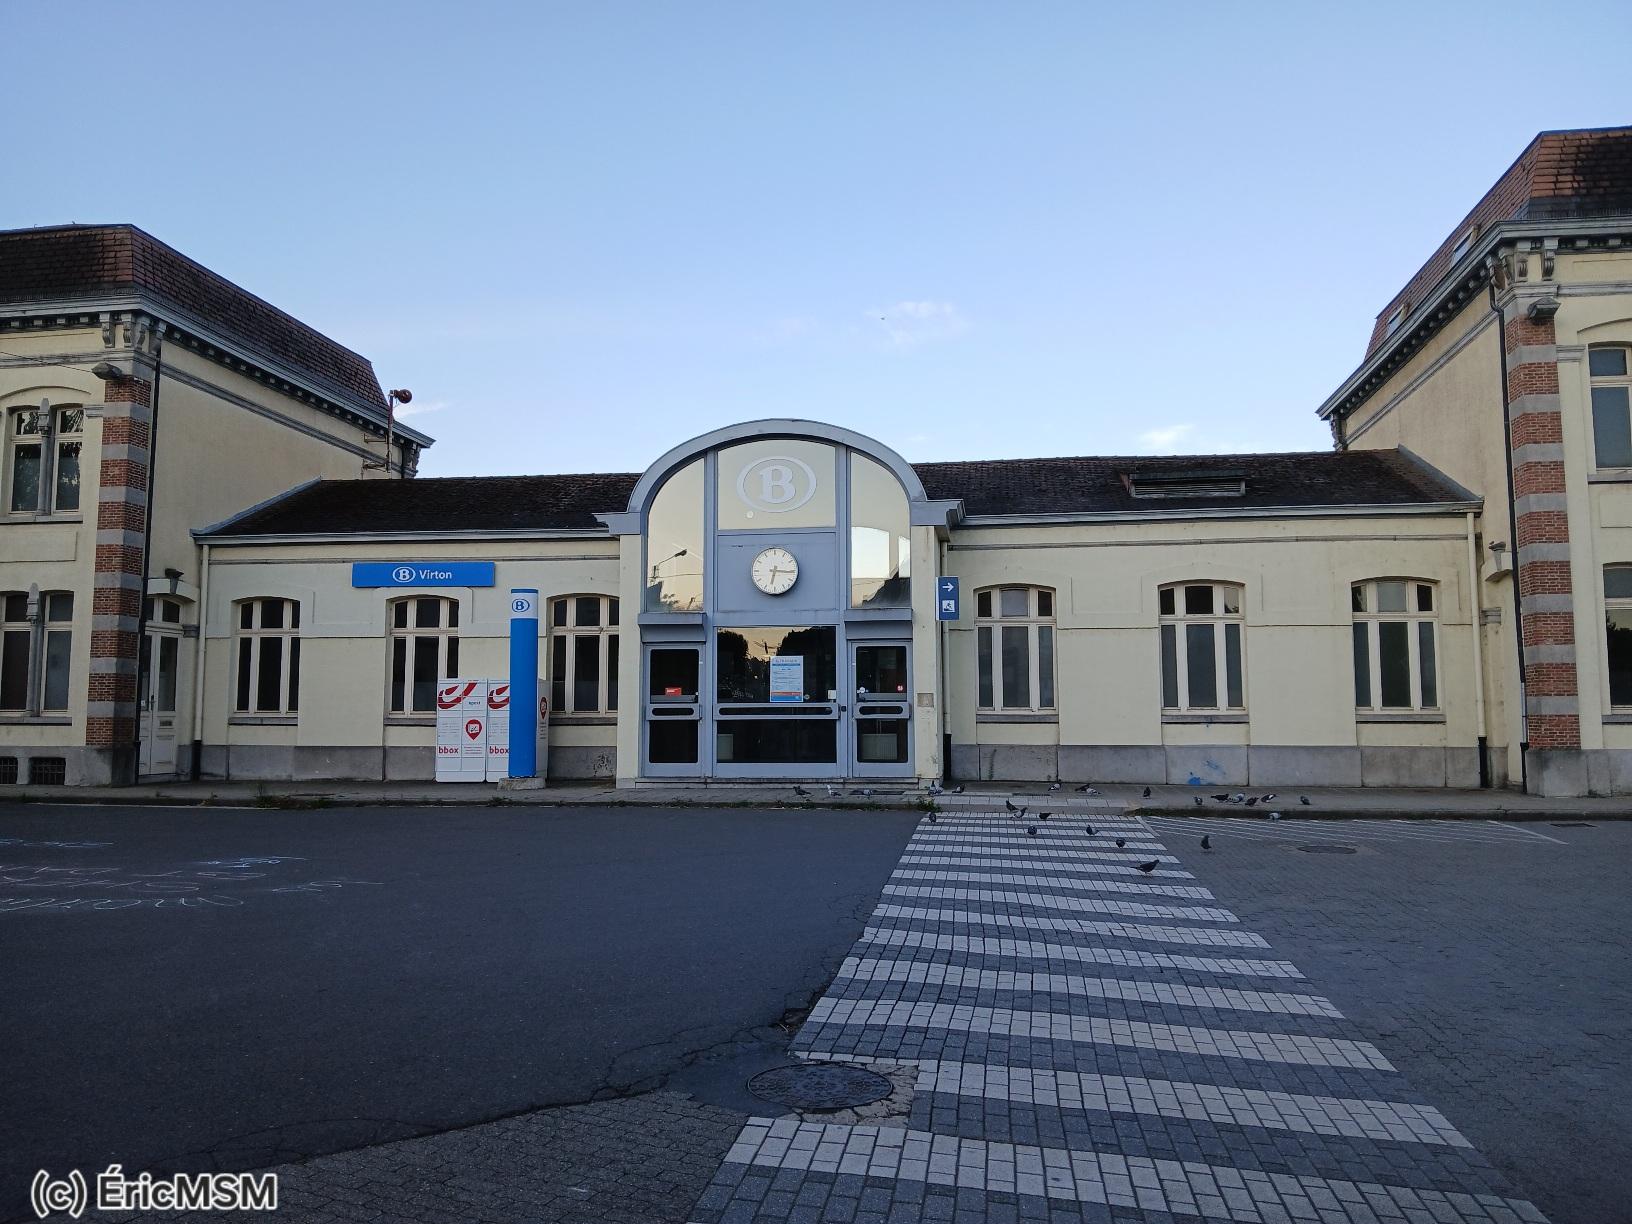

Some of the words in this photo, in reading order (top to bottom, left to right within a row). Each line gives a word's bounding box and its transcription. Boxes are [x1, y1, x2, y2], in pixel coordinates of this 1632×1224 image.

[419, 569, 452, 580] Virton
[438, 746, 459, 754] bbox
[489, 746, 509, 754] bbox
